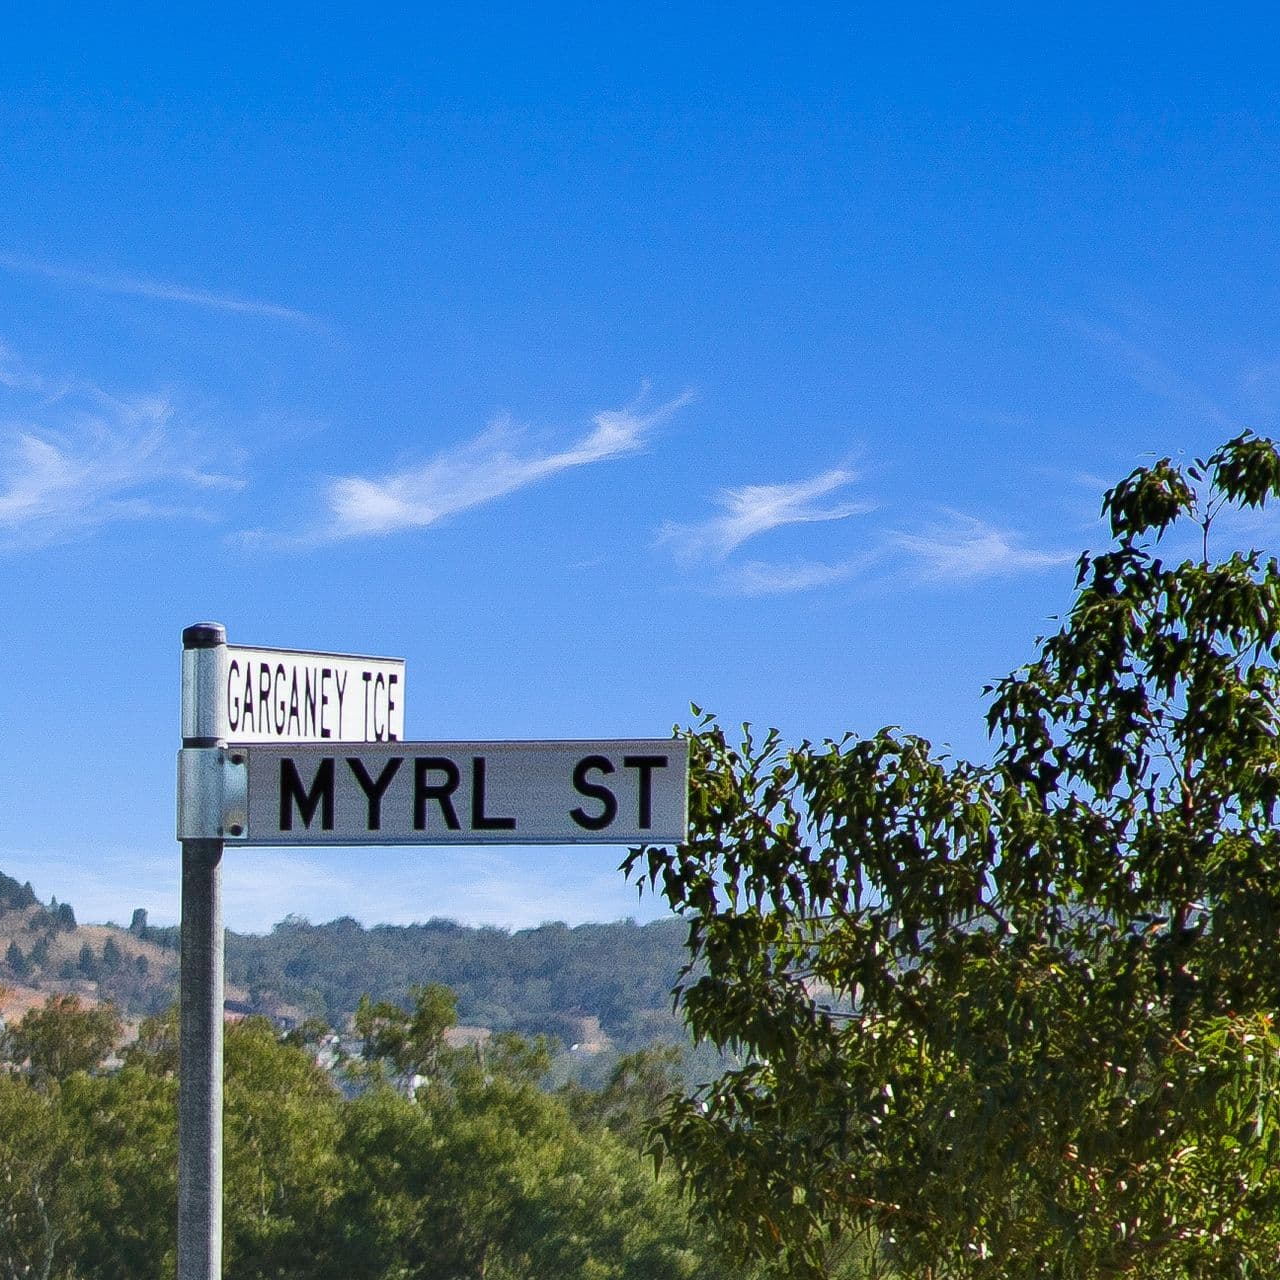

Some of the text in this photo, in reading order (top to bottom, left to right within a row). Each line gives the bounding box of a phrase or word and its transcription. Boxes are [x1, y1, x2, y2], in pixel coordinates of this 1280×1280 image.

[227, 659, 398, 742] GARGANEY TCE
[279, 754, 669, 831] MYRL ST
